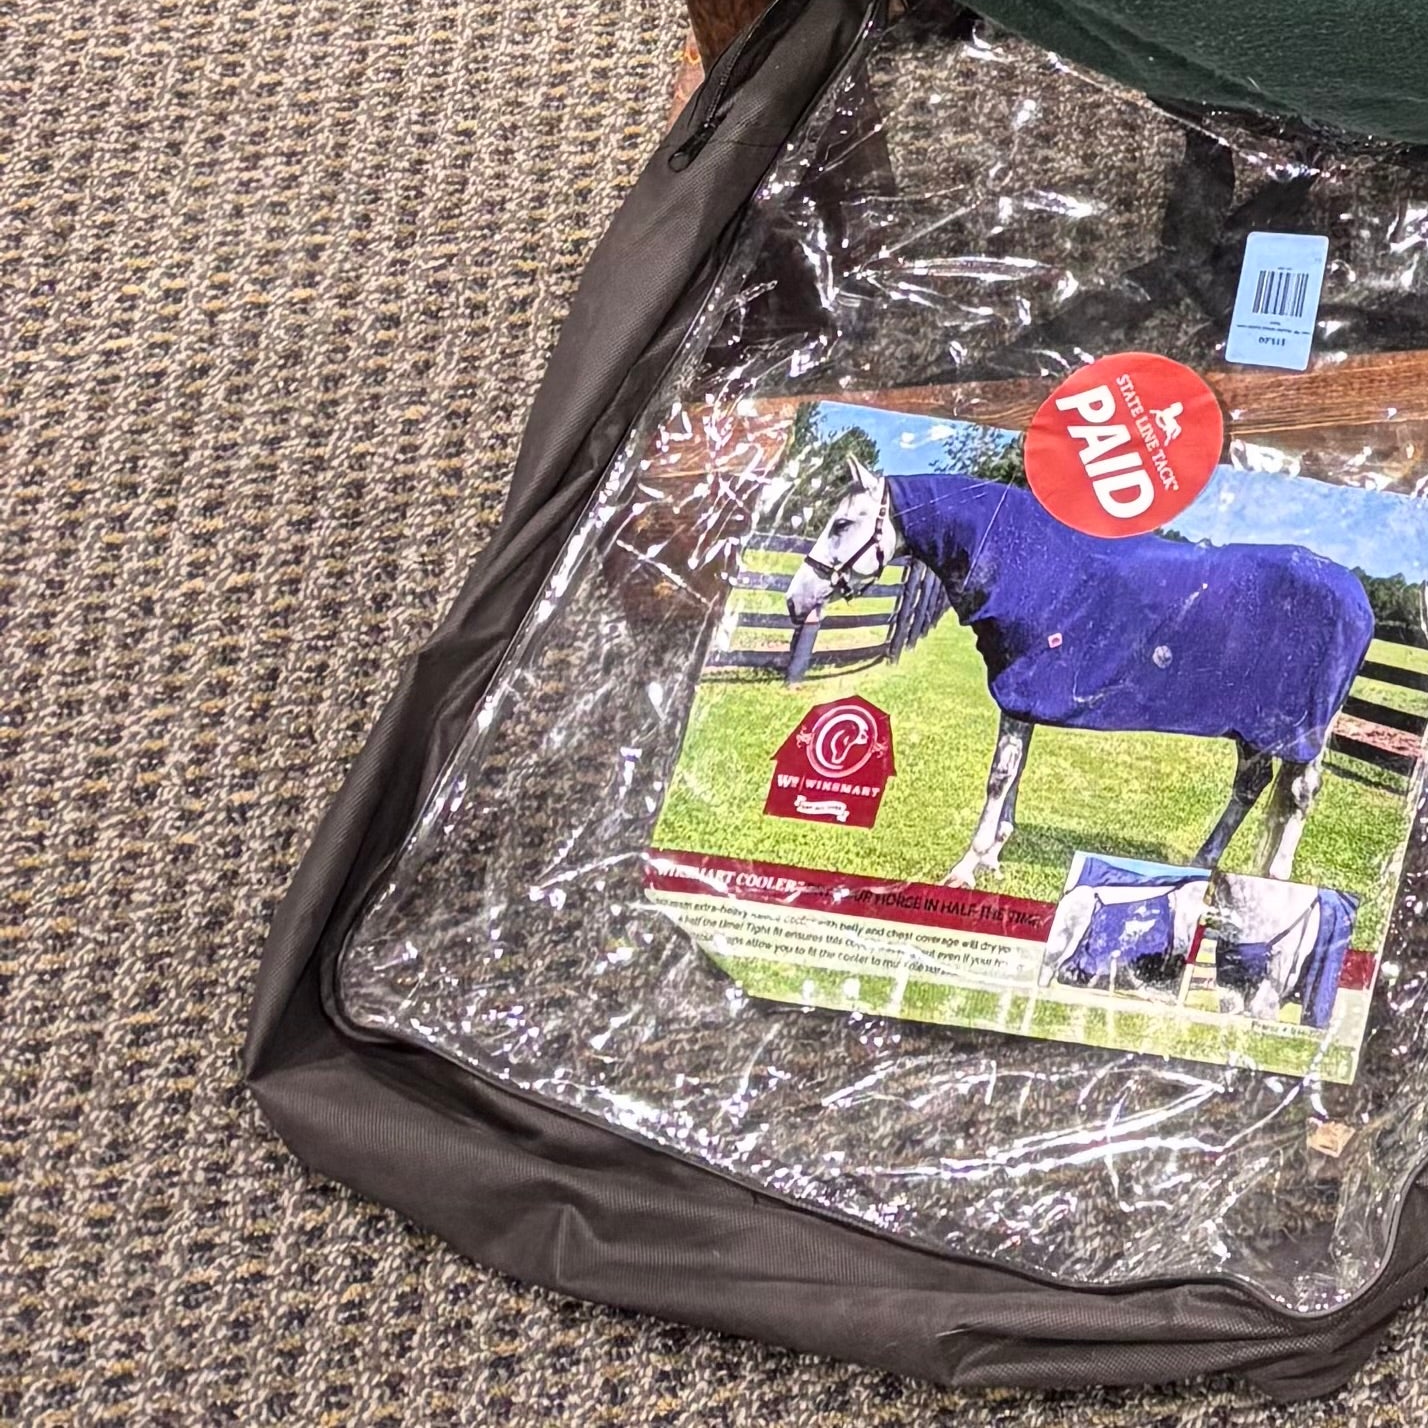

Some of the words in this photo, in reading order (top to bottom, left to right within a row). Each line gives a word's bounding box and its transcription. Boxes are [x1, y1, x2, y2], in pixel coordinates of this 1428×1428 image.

[1116, 373, 1144, 418] STATE
[1135, 414, 1160, 452] LINE
[1055, 384, 1155, 519] PAID
[875, 893, 921, 910] HORSE
[924, 899, 939, 912] IN
[940, 903, 974, 918] HALF
[702, 917, 718, 927] the
[746, 922, 771, 935] Tight
[773, 926, 783, 936] fit
[784, 931, 823, 943] ensures
[825, 934, 843, 945] this
[937, 951, 961, 962] even
[962, 953, 971, 964] if
[745, 938, 773, 950] allow
[773, 943, 793, 955] you
[794, 946, 806, 955] to
[807, 947, 817, 957] fit
[819, 949, 836, 960] the
[871, 956, 882, 966] to
[865, 928, 885, 937] and
[886, 929, 913, 940] chest
[915, 934, 960, 948] coverage
[980, 942, 997, 953] dry
